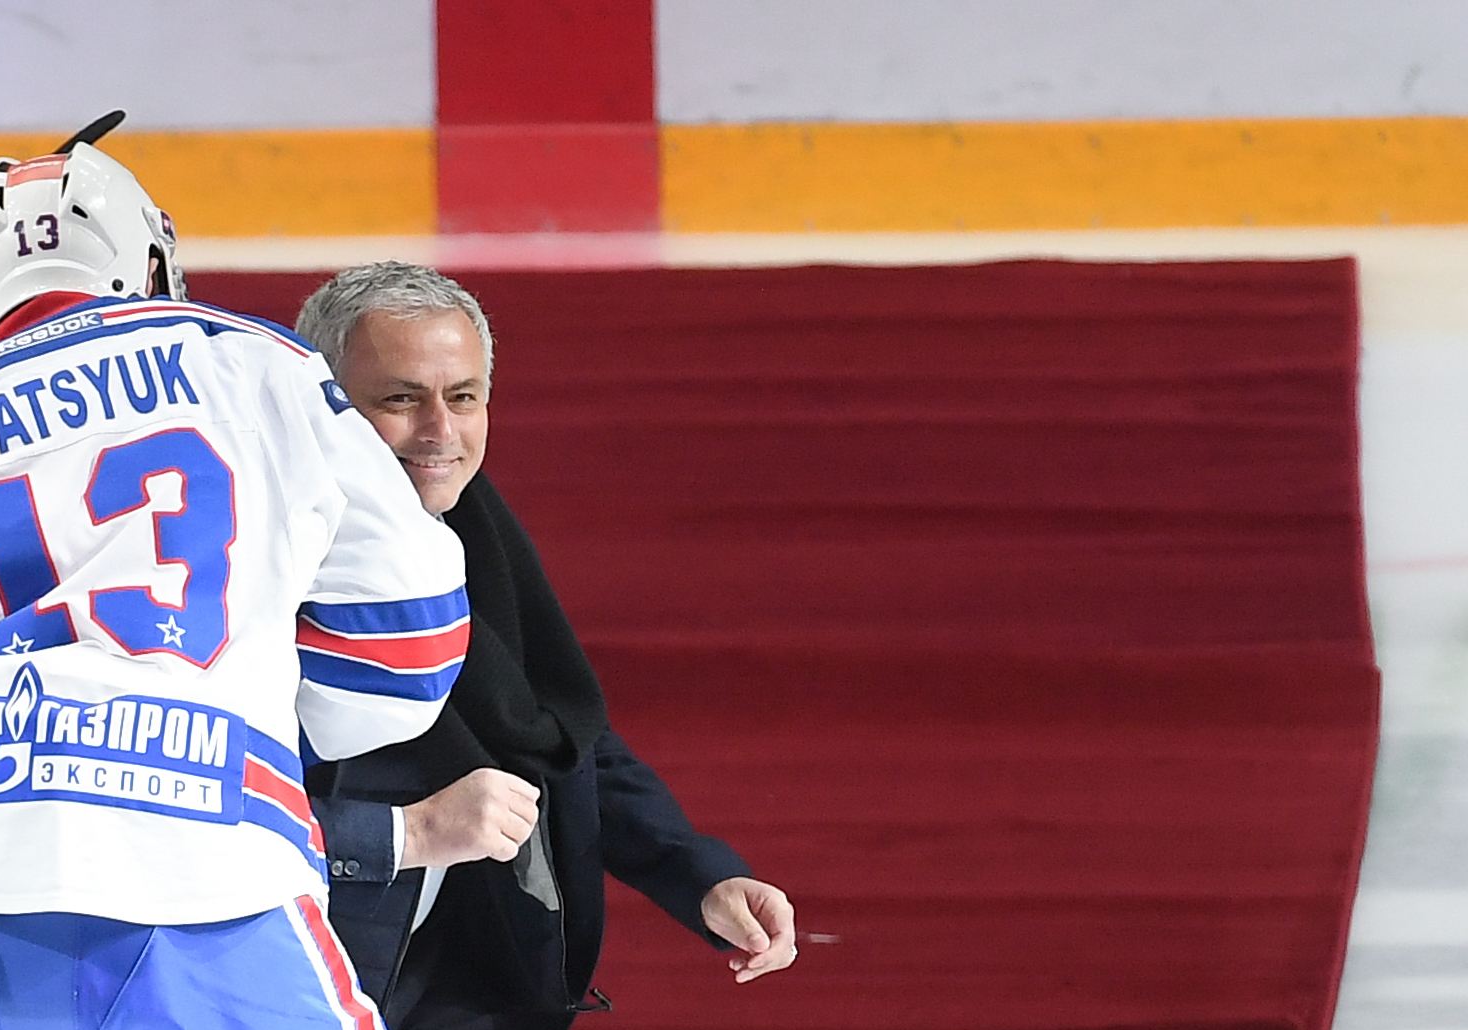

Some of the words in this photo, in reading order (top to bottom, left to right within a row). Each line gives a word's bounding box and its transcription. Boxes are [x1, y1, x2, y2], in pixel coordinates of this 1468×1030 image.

[14, 214, 59, 257] 13
[35, 700, 230, 768] ГАЗПРОМ
[40, 762, 212, 804] ЭКСПОРТ
